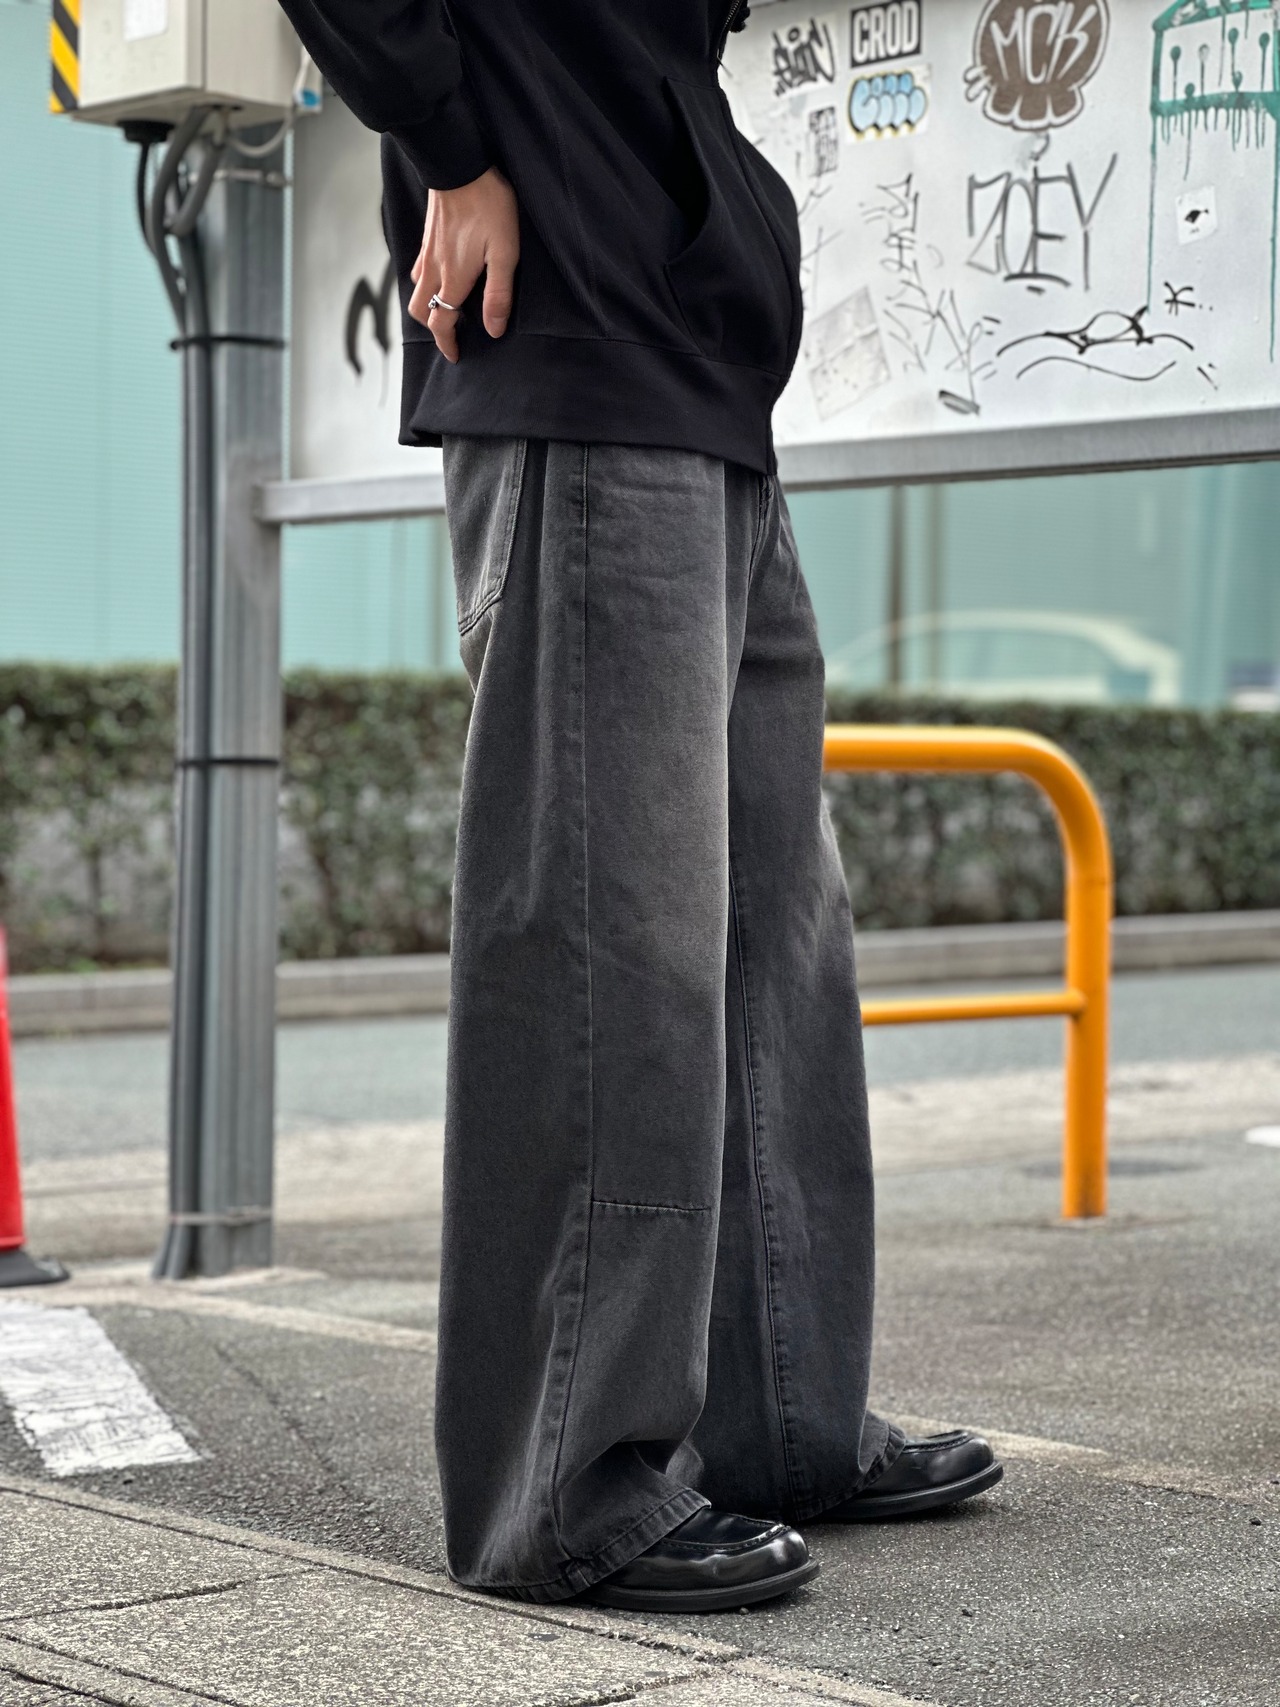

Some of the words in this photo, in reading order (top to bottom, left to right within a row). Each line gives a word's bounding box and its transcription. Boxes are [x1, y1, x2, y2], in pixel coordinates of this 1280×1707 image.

[853, 1, 919, 63] CROD
[990, 1, 1098, 84] MCK
[965, 152, 1117, 292] ZOEY
